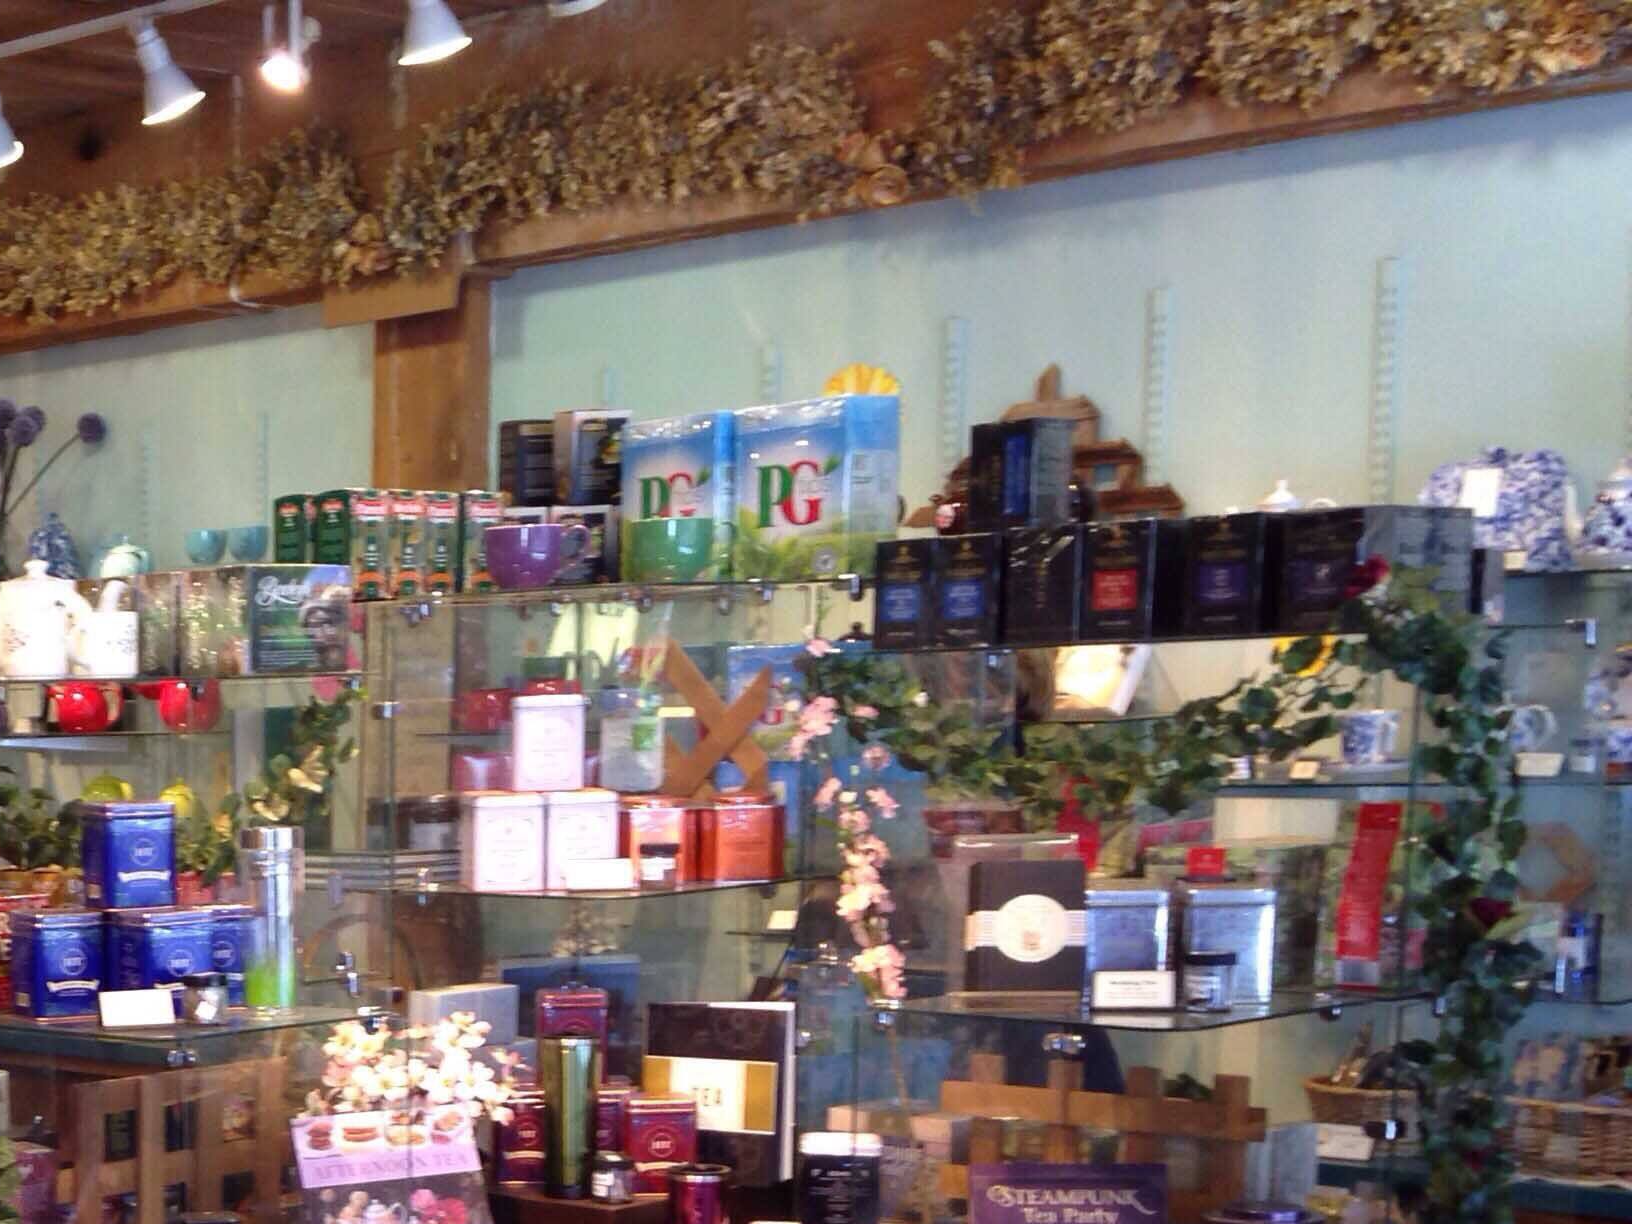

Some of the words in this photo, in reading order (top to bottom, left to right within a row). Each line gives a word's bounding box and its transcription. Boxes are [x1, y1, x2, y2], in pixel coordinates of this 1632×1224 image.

[756, 460, 824, 529] PG
[985, 1184, 1158, 1215] STEAMPUNK
[1022, 1207, 1058, 1224] Tea
